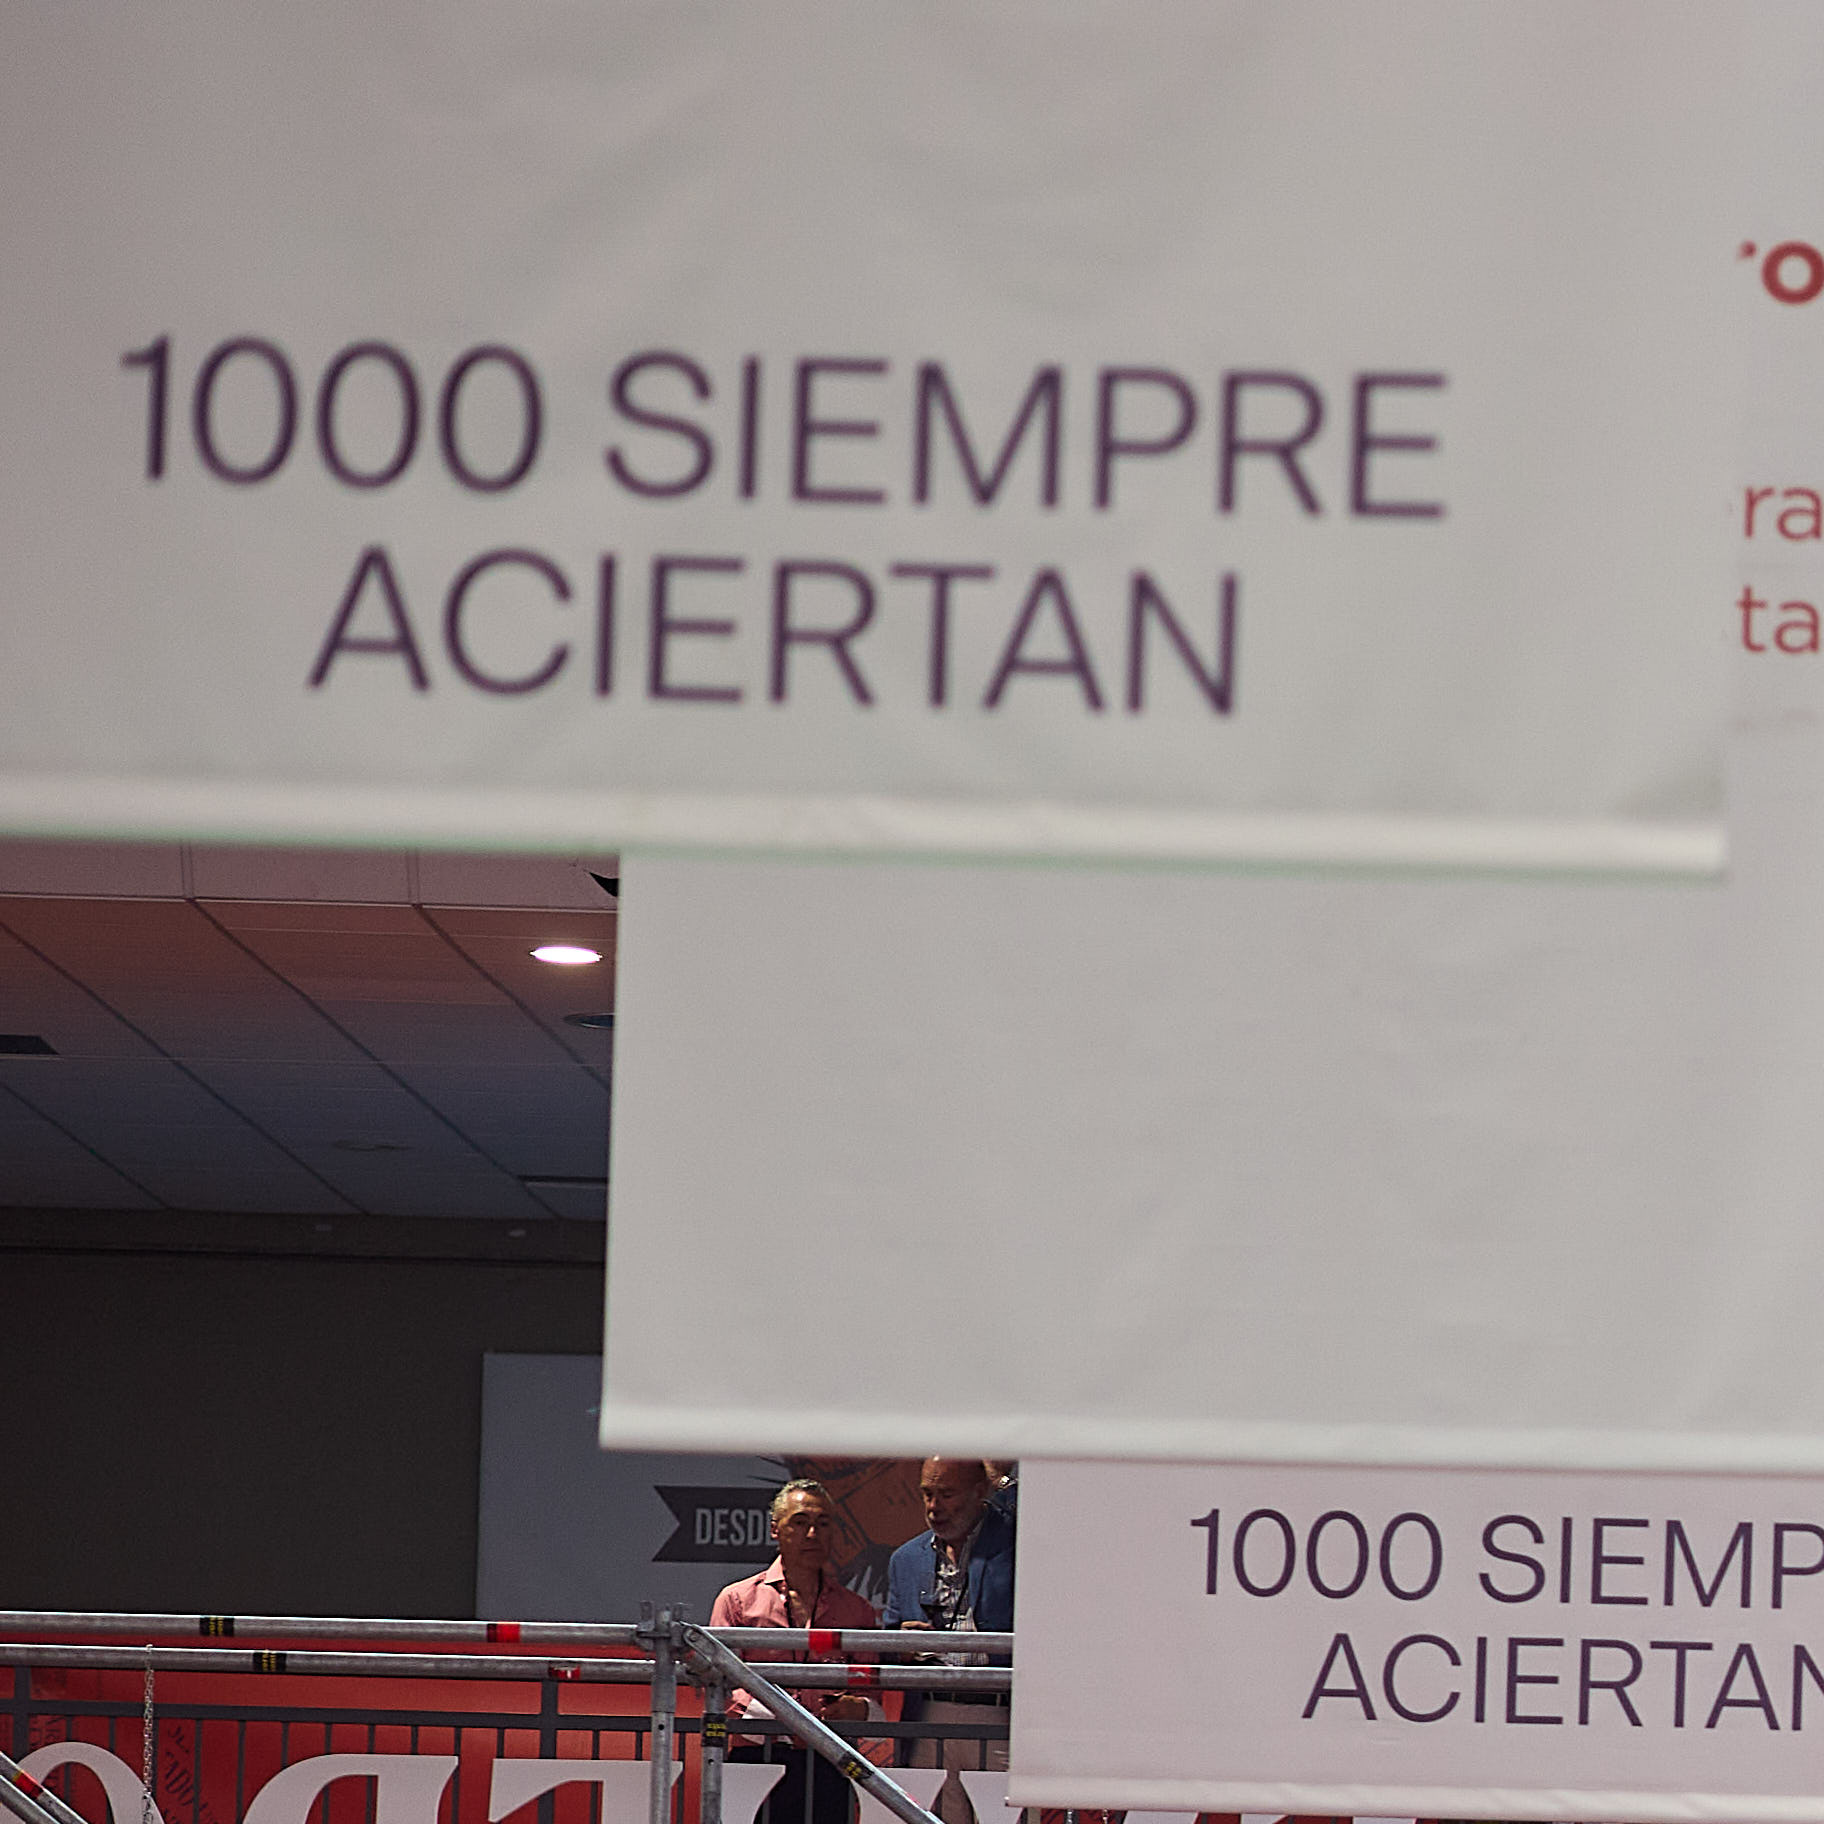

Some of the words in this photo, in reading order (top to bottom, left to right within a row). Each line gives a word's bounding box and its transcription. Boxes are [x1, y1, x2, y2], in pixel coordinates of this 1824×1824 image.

[119, 332, 551, 500] 1000
[600, 343, 1450, 523] SIEMPRE
[303, 541, 1241, 719] ACIERTAN
[1189, 1508, 1443, 1602] 1000
